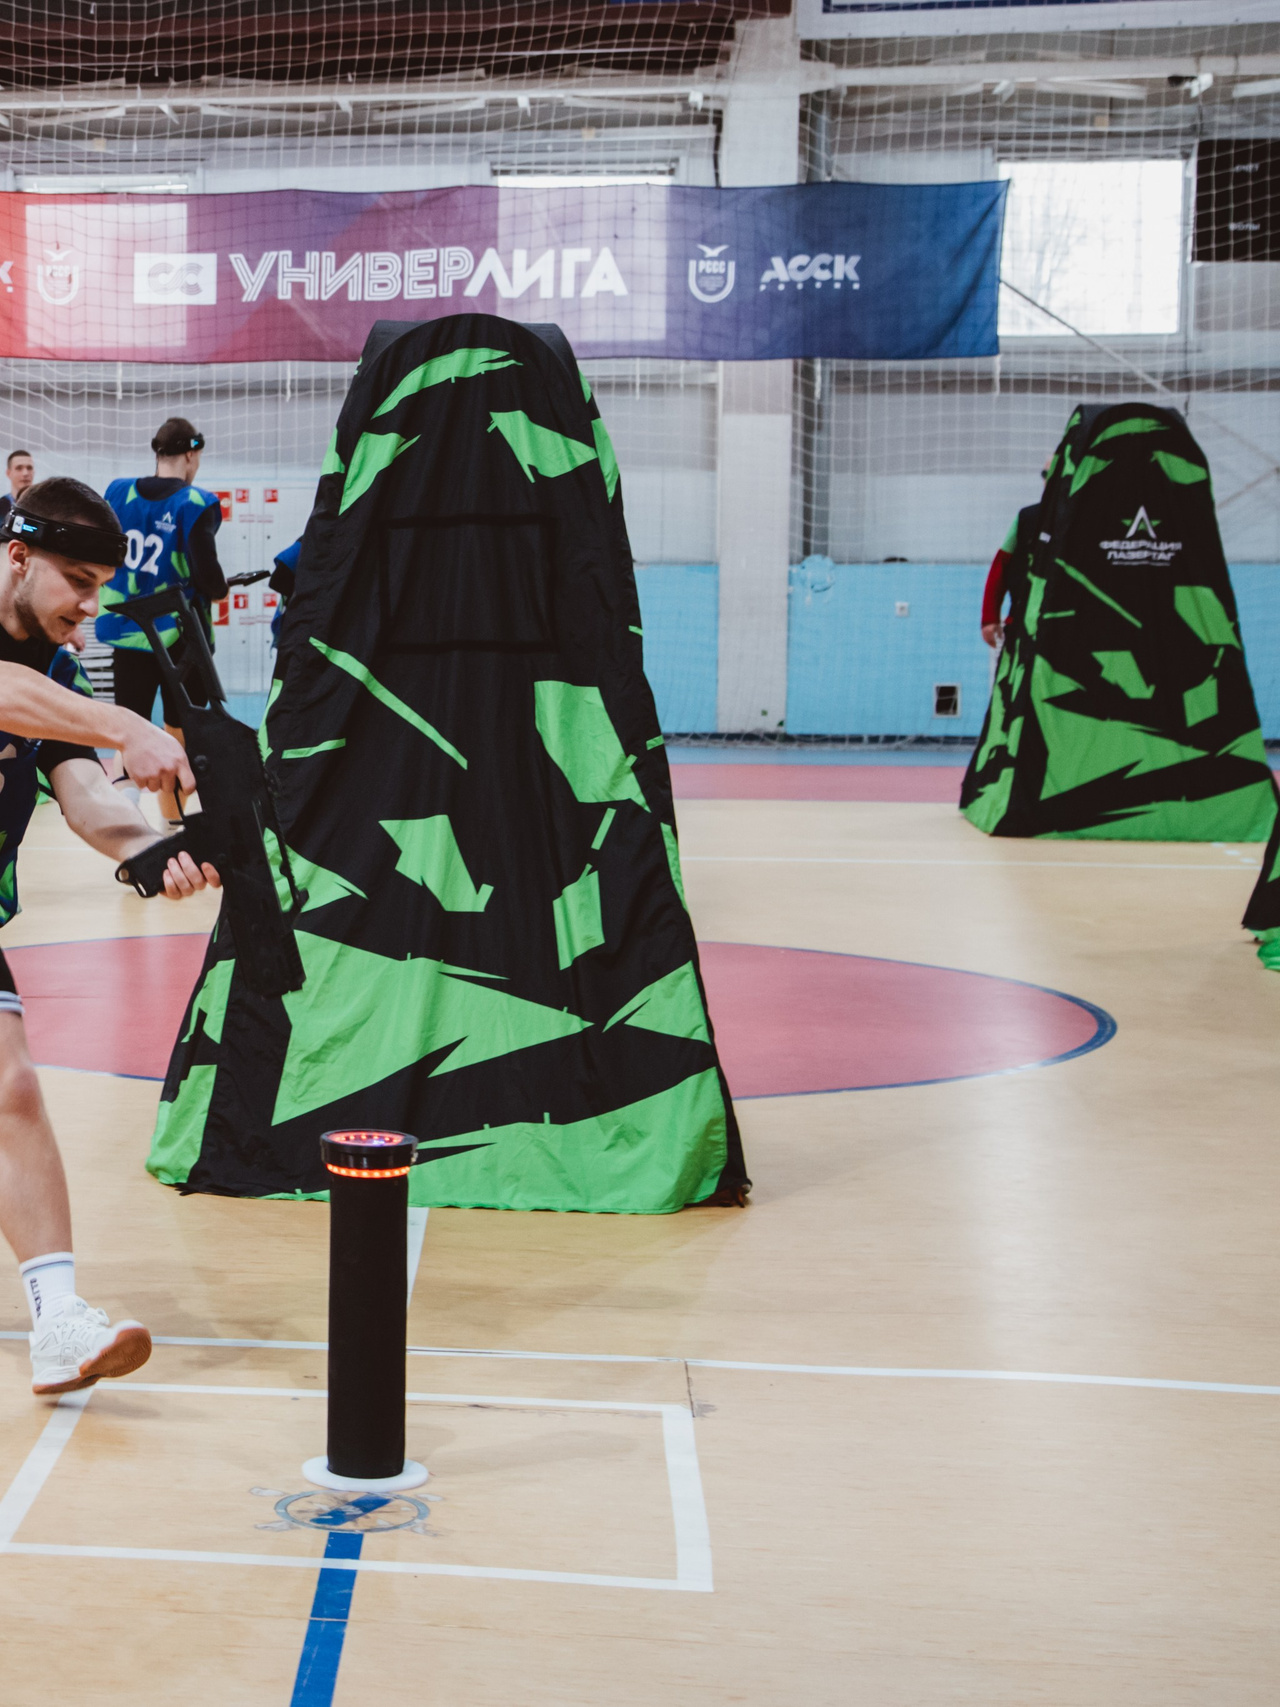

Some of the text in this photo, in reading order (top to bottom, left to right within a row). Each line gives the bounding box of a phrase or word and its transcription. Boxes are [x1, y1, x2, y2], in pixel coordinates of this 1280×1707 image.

[228, 246, 629, 302] УНИВЕРЛИГА
[761, 253, 861, 283] АССК
[124, 529, 163, 576] 02
